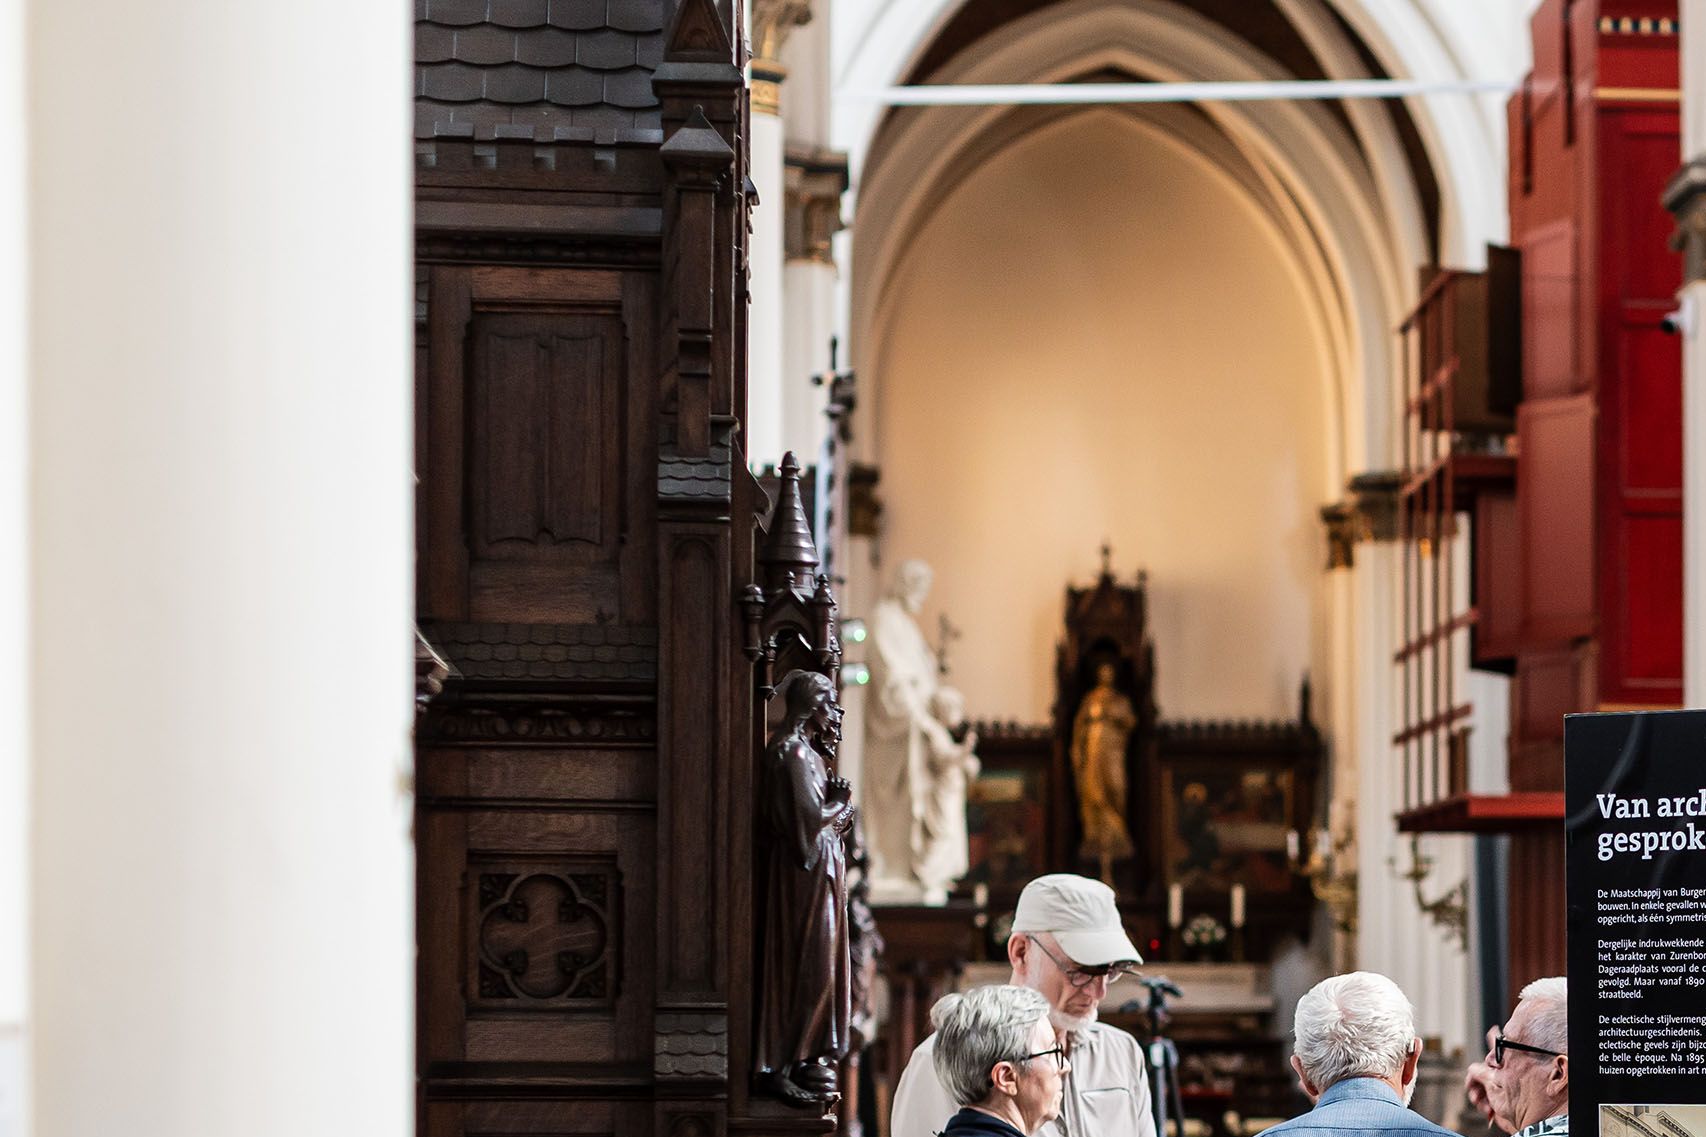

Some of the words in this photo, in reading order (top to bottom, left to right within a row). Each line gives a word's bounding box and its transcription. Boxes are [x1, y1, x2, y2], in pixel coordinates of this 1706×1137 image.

[1596, 792, 1649, 819] Van
[1597, 889, 1608, 898] De
[1610, 887, 1660, 900] Maatschappij
[1597, 901, 1630, 911] bouwen.
[1631, 901, 1639, 910] In
[1640, 900, 1664, 910] enkele
[1666, 899, 1698, 912] gevallen
[1597, 913, 1636, 926] opgericht,
[1637, 913, 1648, 922] als
[1648, 913, 1664, 922] één
[1597, 938, 1636, 951] Dergelijke
[1638, 937, 1704, 948] indrukwekkende
[1598, 952, 1611, 961] het
[1615, 951, 1646, 961] karakter
[1598, 963, 1658, 976] Dageraadplaats
[1661, 963, 1686, 973] vooral
[1688, 963, 1699, 972] de
[1598, 976, 1631, 988] gevolgd.
[1633, 977, 1655, 985] Maar
[1658, 975, 1681, 985] vanaf
[1685, 975, 1704, 987] 1890
[1598, 989, 1643, 999] straatbeeld.
[1598, 1015, 1609, 1024] De
[1611, 1014, 1654, 1024] eclectische
[1598, 1027, 1702, 1039] architectuurgeschiedenis.
[1598, 1040, 1641, 1049] eclectische
[1643, 1040, 1669, 1051] gevels
[1671, 1040, 1686, 1051] zijn
[1598, 1052, 1609, 1062] de
[1612, 1052, 1631, 1062] belle
[1634, 1052, 1667, 1064] époque.
[1670, 1052, 1682, 1061] Na
[1686, 1052, 1704, 1063] 1895
[1599, 1065, 1624, 1074] huizen
[1626, 1065, 1676, 1077] opgetrokken
[1678, 1065, 1686, 1074] in
[1687, 1066, 1699, 1074] art
